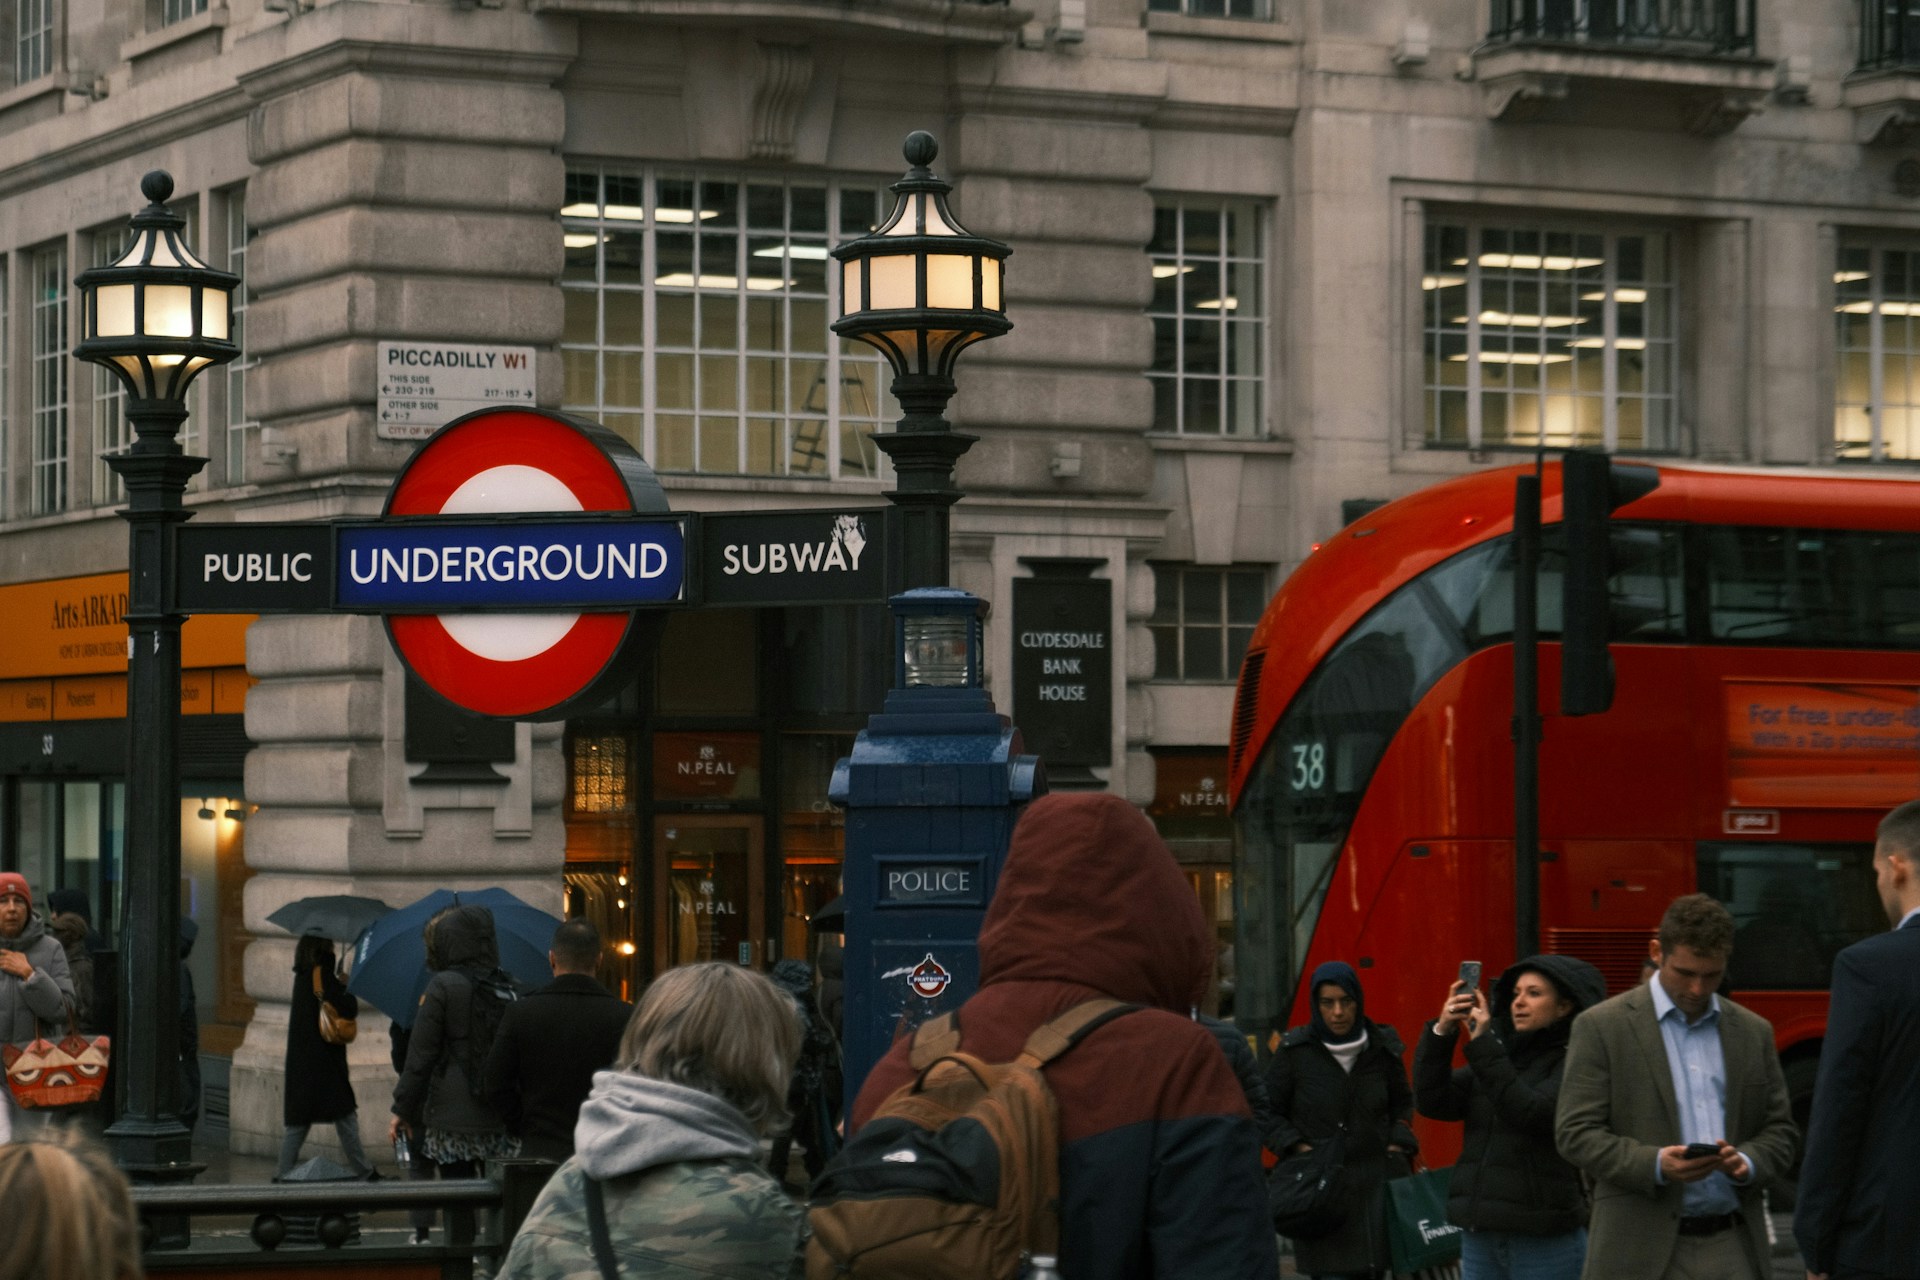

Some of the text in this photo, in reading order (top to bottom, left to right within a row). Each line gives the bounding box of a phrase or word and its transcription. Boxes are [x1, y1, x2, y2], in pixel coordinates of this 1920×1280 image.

[388, 348, 527, 370] PICCADILLY W1
[389, 375, 431, 385] THIS SIDE
[388, 401, 439, 411] OTHER SIDE
[388, 426, 407, 435] CITY
[409, 426, 421, 435] OF
[204, 552, 312, 583] PUBLIC
[349, 542, 669, 584] UNDERGROUND
[722, 541, 867, 575] SUBWAY
[52, 599, 79, 630] Arts
[1021, 632, 1105, 648] CLYDESDALE
[1043, 658, 1082, 674] BANK
[1039, 685, 1087, 701] HOUSE
[1750, 703, 1782, 725] For
[1789, 703, 1829, 725] free
[677, 761, 736, 775] N.PEAL
[1291, 742, 1325, 791] 38
[888, 871, 970, 892] POLICE
